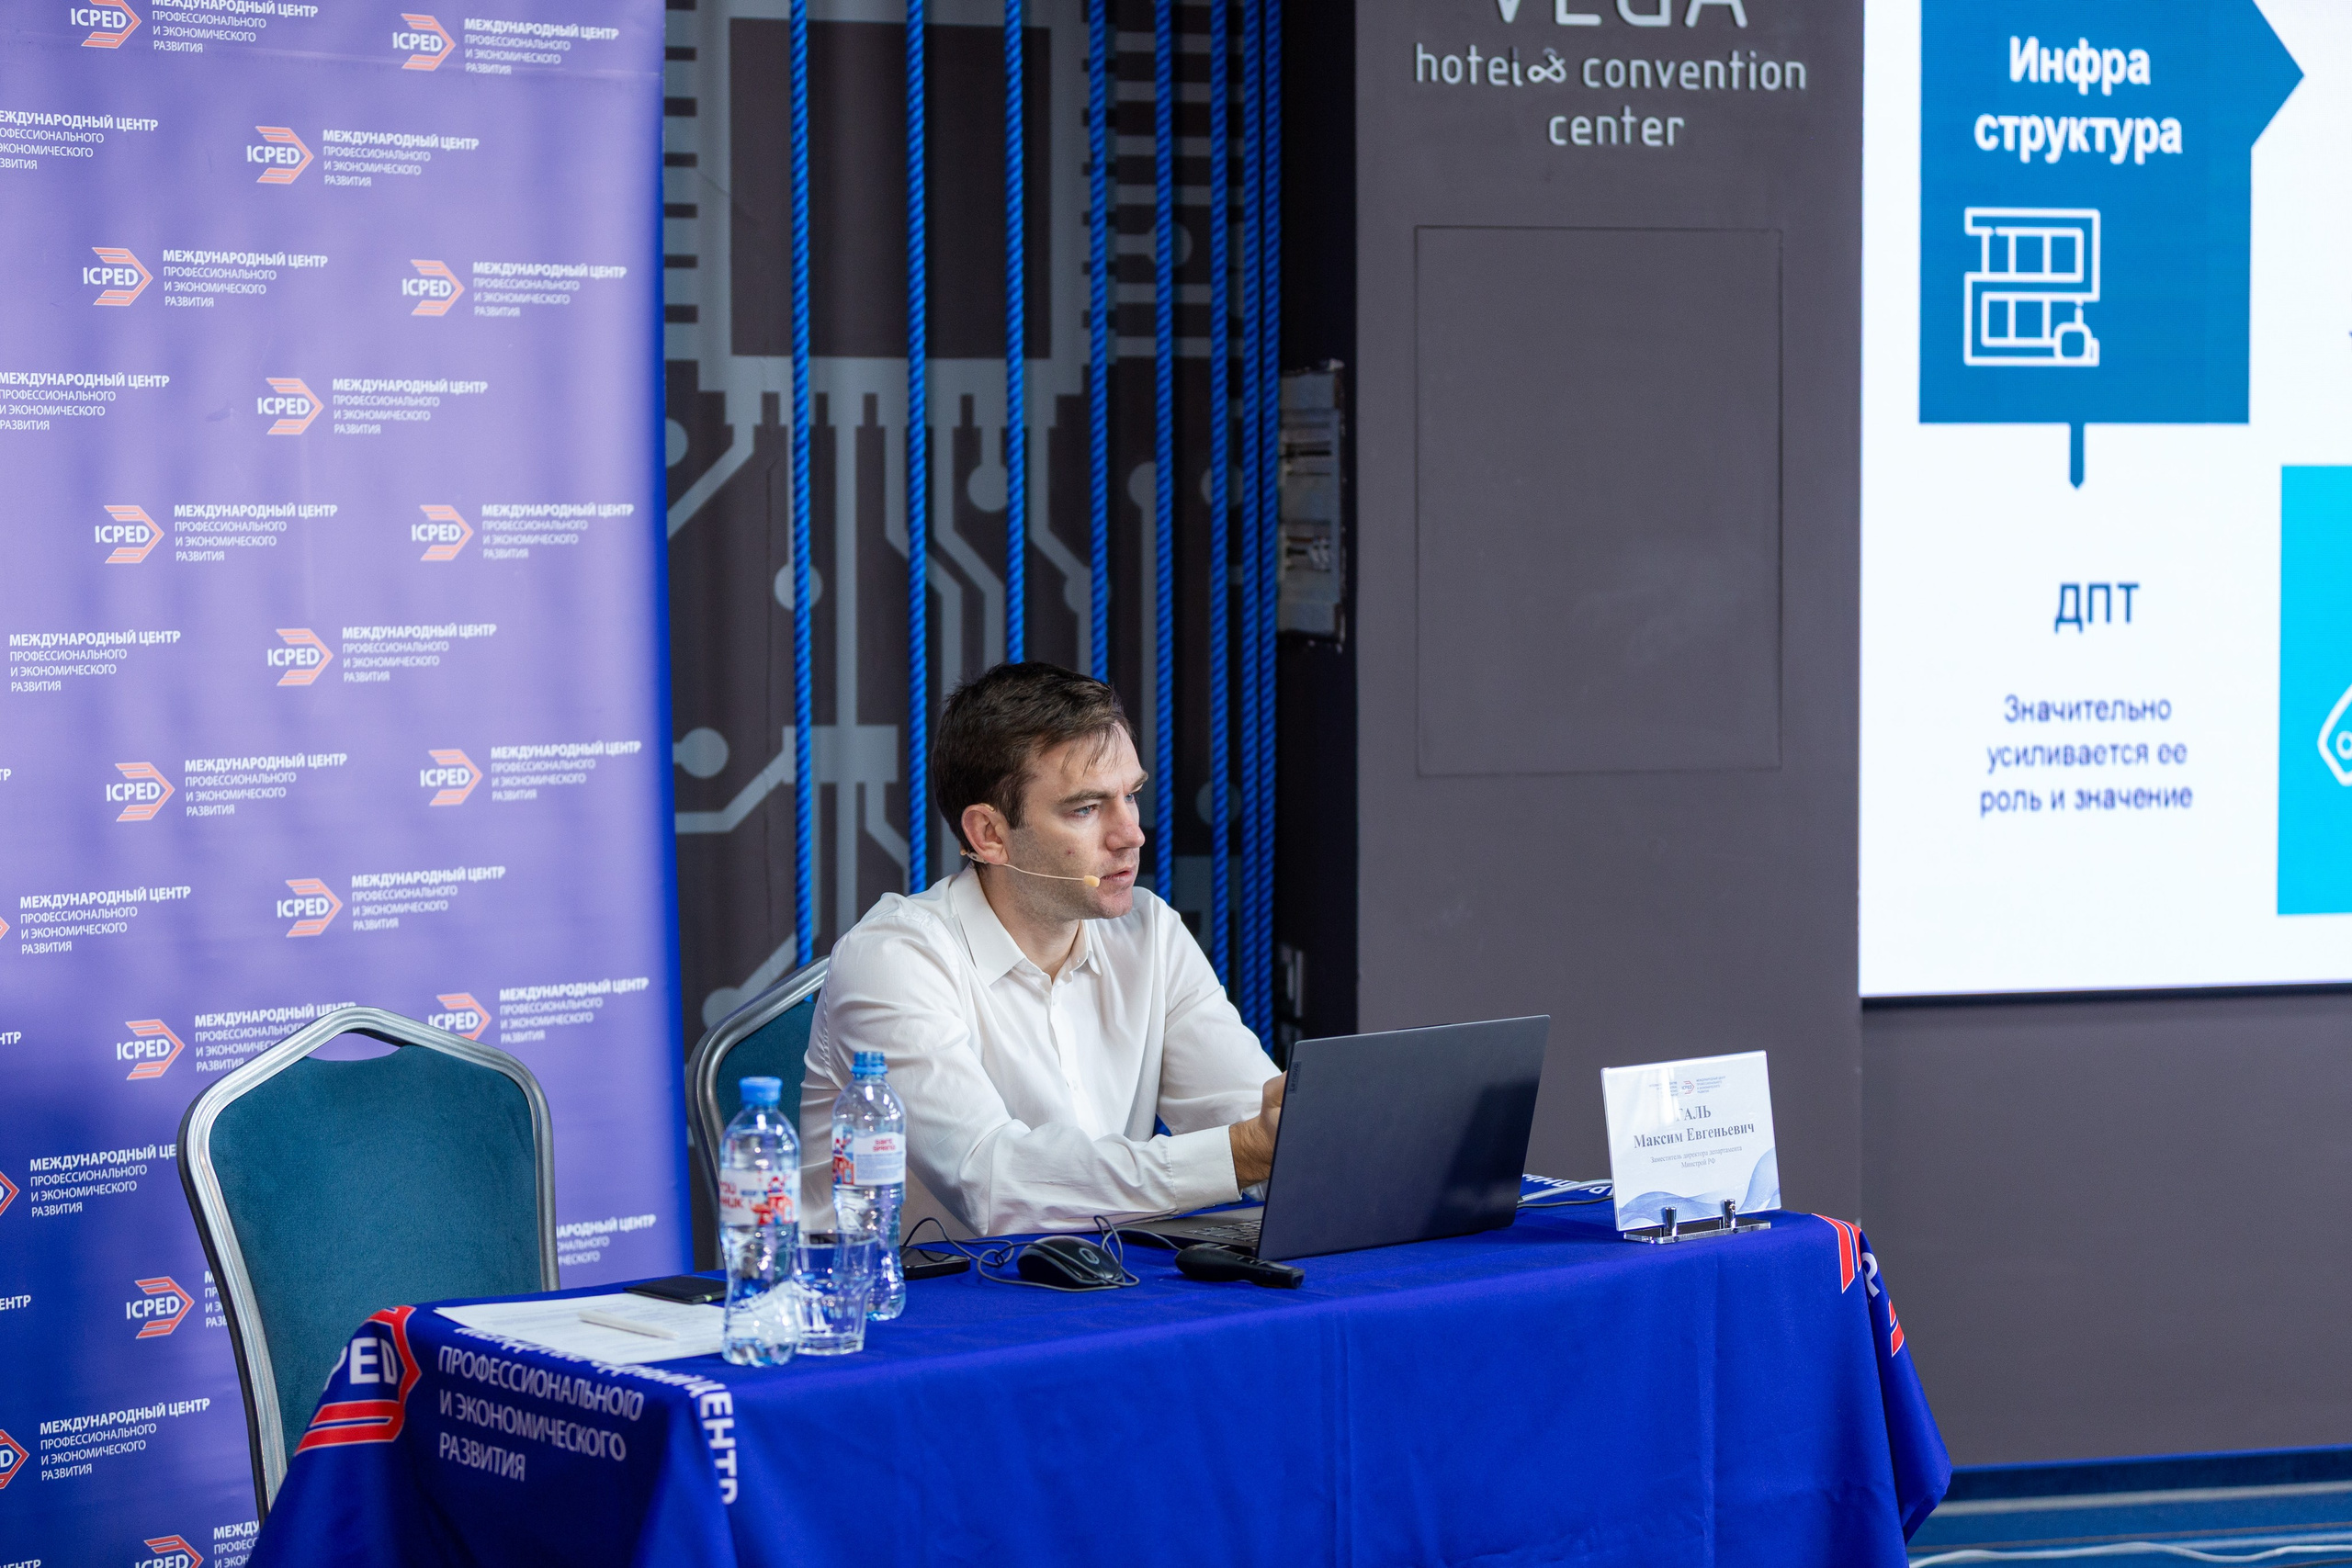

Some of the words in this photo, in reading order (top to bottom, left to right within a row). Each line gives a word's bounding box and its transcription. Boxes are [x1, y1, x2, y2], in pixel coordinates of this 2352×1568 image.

[71, 8, 126, 28] ICPED
[153, 10, 266, 28] ПРОФЕССИОНАЛЬНОГО
[278, 4, 318, 17] ЦЕНТР
[153, 25, 160, 36] И
[163, 25, 256, 42] ЭКОНОМИЧЕСКОГО
[464, 17, 579, 38] МЕЖДУНАРОДНЫЙ
[581, 26, 619, 40] ЦЕНТР
[153, 39, 203, 53] РАЗВИТИЯ
[393, 32, 442, 51] ICPED
[464, 34, 571, 51] ПРОФЕССИОНАЛЬНОГО
[474, 48, 561, 65] ЭКОНОМИЧЕСКОГО
[2009, 35, 2151, 96] Инфра
[1583, 50, 1806, 90] convention
[0, 110, 113, 130] ЕЖДУНАРОДНЫЙ
[117, 117, 158, 132] ЦЕНТР
[1548, 106, 1685, 146] center
[0, 128, 104, 143] ОФЕССИОНАЛЬНОГО
[322, 129, 438, 149] МЕЖДУНАРОДНЫЙ
[441, 136, 480, 151] ЦЕНТР
[1974, 113, 2183, 165] структура
[247, 145, 300, 164] ICPED
[323, 145, 431, 163] ПРОФЕССИОНАЛЬНОГО
[0, 158, 37, 170] ЗВИТИЯ
[333, 160, 422, 175] ЭКОНОМИЧЕСКОГО
[324, 175, 371, 186] РАЗВИТИЯ
[163, 249, 286, 268] МЕЖДУНАРОДНЫЙ
[288, 254, 328, 269] ЦЕНТР
[84, 266, 138, 286] ICPED
[164, 264, 277, 281] ПРОФЕССИОНАЛЬНОГО
[164, 280, 172, 291] И
[174, 281, 266, 295] ЭКОНОМИЧЕСКОГО
[402, 278, 451, 297] ICPED
[164, 295, 214, 308] РАЗВИТИЯ
[0, 371, 125, 389] МЕЖДУНАРОДНЫЙ
[128, 374, 170, 389] ЦЕНТР
[333, 378, 448, 394] МЕЖДУНАРОДНЫЙ
[449, 380, 488, 395] ЦЕНТР
[0, 389, 116, 401] ПРОФЕССИОНАЛЬНОГО
[333, 394, 440, 408] ПРОФЕССИОНАЛЬНОГО
[0, 405, 6, 415] И
[9, 404, 105, 417] ЭКОНОМИЧЕСКОГО
[257, 398, 310, 415] ICPED
[343, 409, 431, 422] ЭКОНОМИЧЕСКОГО
[0, 420, 50, 431] РАЗВИТИЯ
[334, 423, 381, 434] РАЗВИТИЯ
[175, 502, 296, 520] МЕЖДУНАРОДНЫЙ
[299, 505, 337, 520] ЦЕНТР
[96, 525, 149, 543] ICPED
[175, 521, 287, 533] ПРОФЕССИОНАЛЬНОГО
[412, 525, 460, 541] ICPED
[175, 536, 183, 547] И
[185, 536, 277, 547] ЭКОНОМИЧЕСКОГО
[175, 551, 224, 562] РАЗВИТИЯ
[2054, 582, 2139, 634] ДПТ
[9, 628, 136, 649] МЕЖДУНАРОДНЫЙ
[139, 630, 181, 647] ЦЕНТР
[343, 622, 458, 641] МЕЖДУНАРОДНЫЙ
[458, 623, 497, 639] ЦЕНТР
[10, 648, 127, 662] ПРОФЕССИОНАЛЬНОГО
[343, 640, 449, 654] ПРОФЕССИОНАЛЬНОГО
[267, 649, 320, 666] ICPED
[352, 655, 440, 669] ЭКОНОМИЧЕСКОГО
[11, 666, 17, 677] И
[20, 664, 117, 677] ЭКОНОМИЧЕСКОГО
[344, 671, 390, 683] РАЗВИТИЯ
[11, 680, 61, 693] РАЗВИТИЯ
[2004, 694, 2172, 723] Значительно
[185, 752, 305, 773] МЕЖДУНАРОДНЫЙ
[308, 752, 347, 770] ЦЕНТР
[1987, 742, 2149, 774] усиливается
[2157, 743, 2188, 765] ее
[186, 771, 297, 787] ПРОФЕССИОНАЛЬНОГО
[421, 768, 469, 786] ICPED
[107, 783, 160, 801] ICPED
[186, 792, 193, 803] И
[196, 786, 287, 802] ЭКОНОМИЧЕСКОГО
[187, 804, 234, 818] РАЗВИТИЯ
[1981, 788, 2041, 818] роль
[2051, 789, 2065, 810] и
[2074, 786, 2193, 810] значение
[352, 866, 466, 889] МЕЖДУНАРОДНЫЙ
[468, 865, 505, 883] ЦЕНТР
[20, 886, 146, 909] МЕЖДУНАРОДНЫЙ
[150, 886, 191, 903] ЦЕНТР
[352, 885, 458, 902] ПРОФЕССИОНАЛЬНОГО
[21, 906, 138, 924] ПРОФЕССИОНАЛЬНОГО
[277, 897, 329, 918] ICPED
[361, 899, 448, 917] ЭКОНОМИЧЕСКОГО
[21, 929, 28, 940] И
[31, 921, 127, 940] ЭКОНОМИЧЕСКОГО
[353, 917, 399, 931] РАЗВИТИЯ
[22, 941, 72, 954] РАЗВИТИЯ
[195, 1003, 314, 1028] МЕЖДУНАРОДНЫЙ
[429, 1011, 479, 1031] ICPED
[117, 1039, 170, 1060] ICPED
[196, 1046, 203, 1057] И
[1634, 1132, 1683, 1149] Максим
[1687, 1122, 1755, 1141] Евгеньевич
[30, 1145, 156, 1172] МЕЖДУНАРОДНЫЙ
[1650, 1154, 1682, 1163] Заместитель
[1683, 1150, 1709, 1160] директора
[1709, 1145, 1743, 1156] департамента
[30, 1165, 147, 1188] ПРОФЕССИОНАЛЬНОГО
[31, 1191, 39, 1202] И
[41, 1180, 137, 1201] ЭКОНОМИЧЕСКОГО
[32, 1201, 82, 1218] РАЗВИТИЯ
[0, 1294, 32, 1311] ЕНТР
[127, 1296, 179, 1319] ICPED
[437, 1345, 644, 1422] ПРОФЕССИОНАЛЬНОГО
[40, 1402, 165, 1435] МЕЖДУНАРОДНЫЙ
[169, 1398, 209, 1418] ЦЕНТР
[439, 1389, 452, 1416] И
[457, 1394, 627, 1461] ЭКОНОМИЧЕСКОГО
[40, 1423, 156, 1450] ПРОФЕССИОНАЛЬНОГО
[41, 1454, 49, 1466] И
[51, 1439, 146, 1464] ЭКОНОМИЧЕСКОГО
[439, 1432, 526, 1482] РАЗВИТИЯ
[41, 1463, 92, 1482] РАЗВИТИЯ
[136, 1554, 188, 1568] PED
